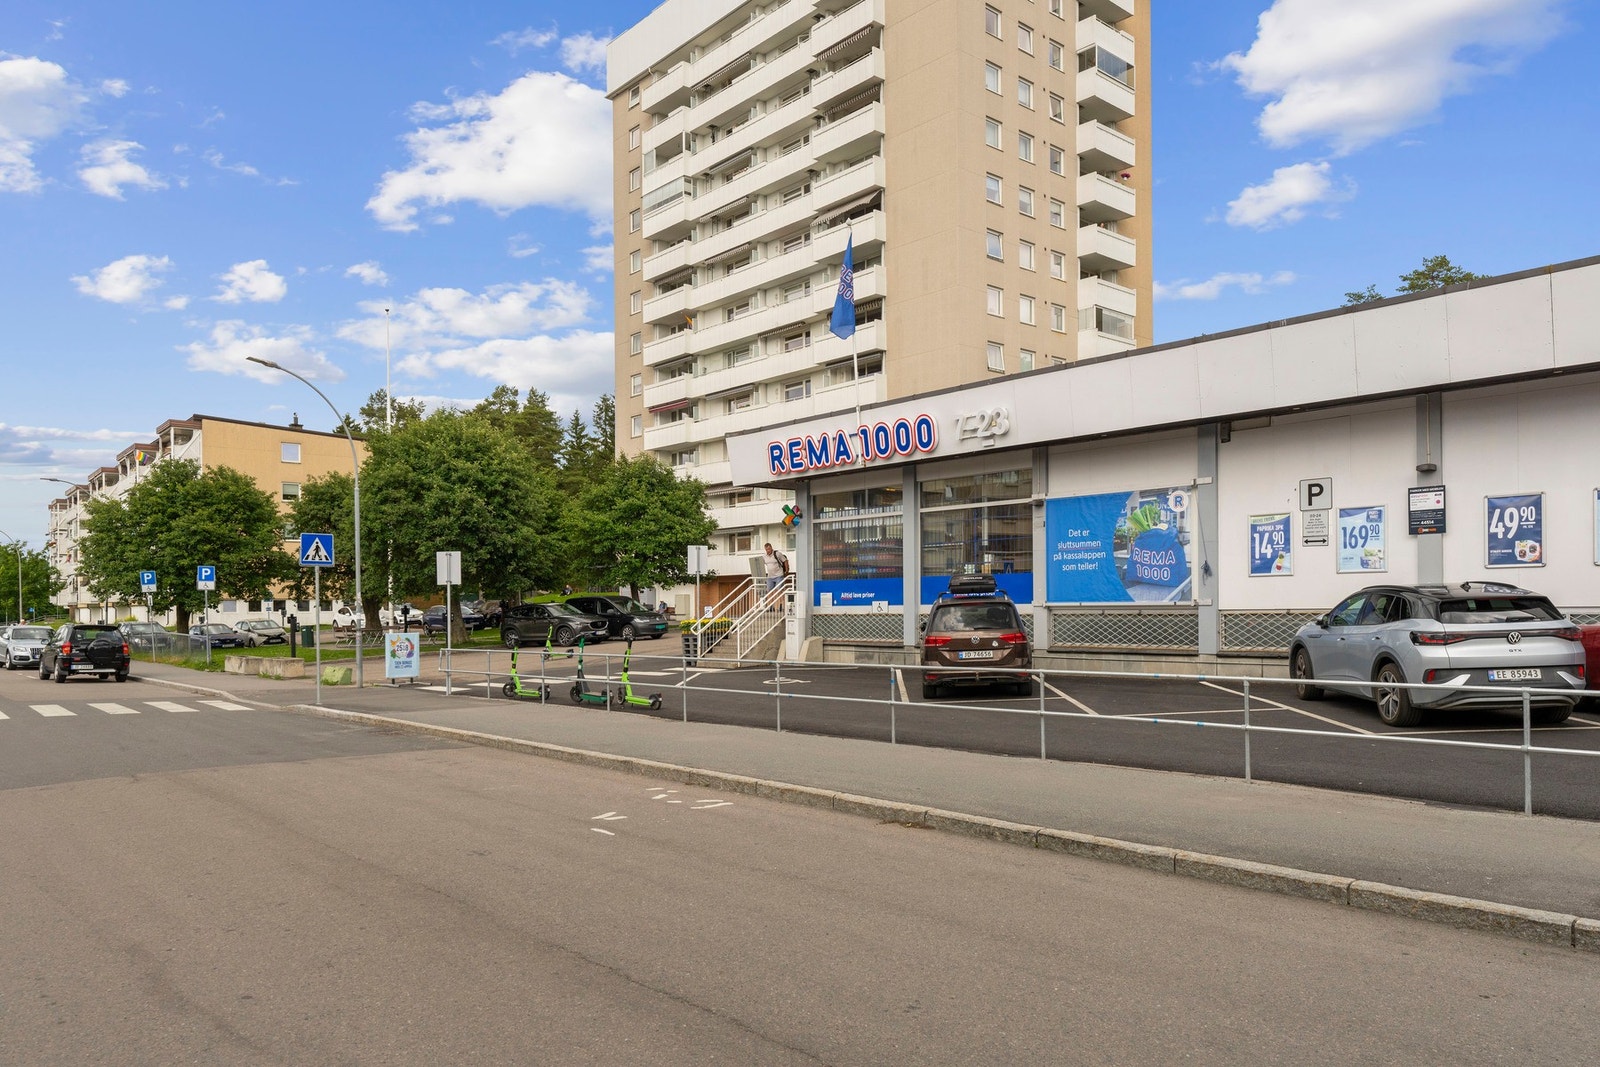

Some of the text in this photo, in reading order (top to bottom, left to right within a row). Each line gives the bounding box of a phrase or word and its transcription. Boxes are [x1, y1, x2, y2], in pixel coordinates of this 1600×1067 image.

[768, 414, 936, 476] REMA 1000
[1308, 483, 1323, 506] P
[1174, 495, 1183, 508] R
[1489, 506, 1535, 539] 49 90
[1068, 529, 1080, 537] Det
[1342, 524, 1380, 549] 169 90
[1057, 540, 1101, 549] sluttsummen
[1254, 532, 1284, 559] 14 90
[1053, 551, 1106, 561] på kassalappen
[1132, 548, 1176, 566] REMA
[1078, 562, 1099, 570] teller!
[144, 573, 152, 584] P
[202, 568, 211, 580] P
[1136, 566, 1171, 581] 1000
[1496, 670, 1538, 678] EE 85943
